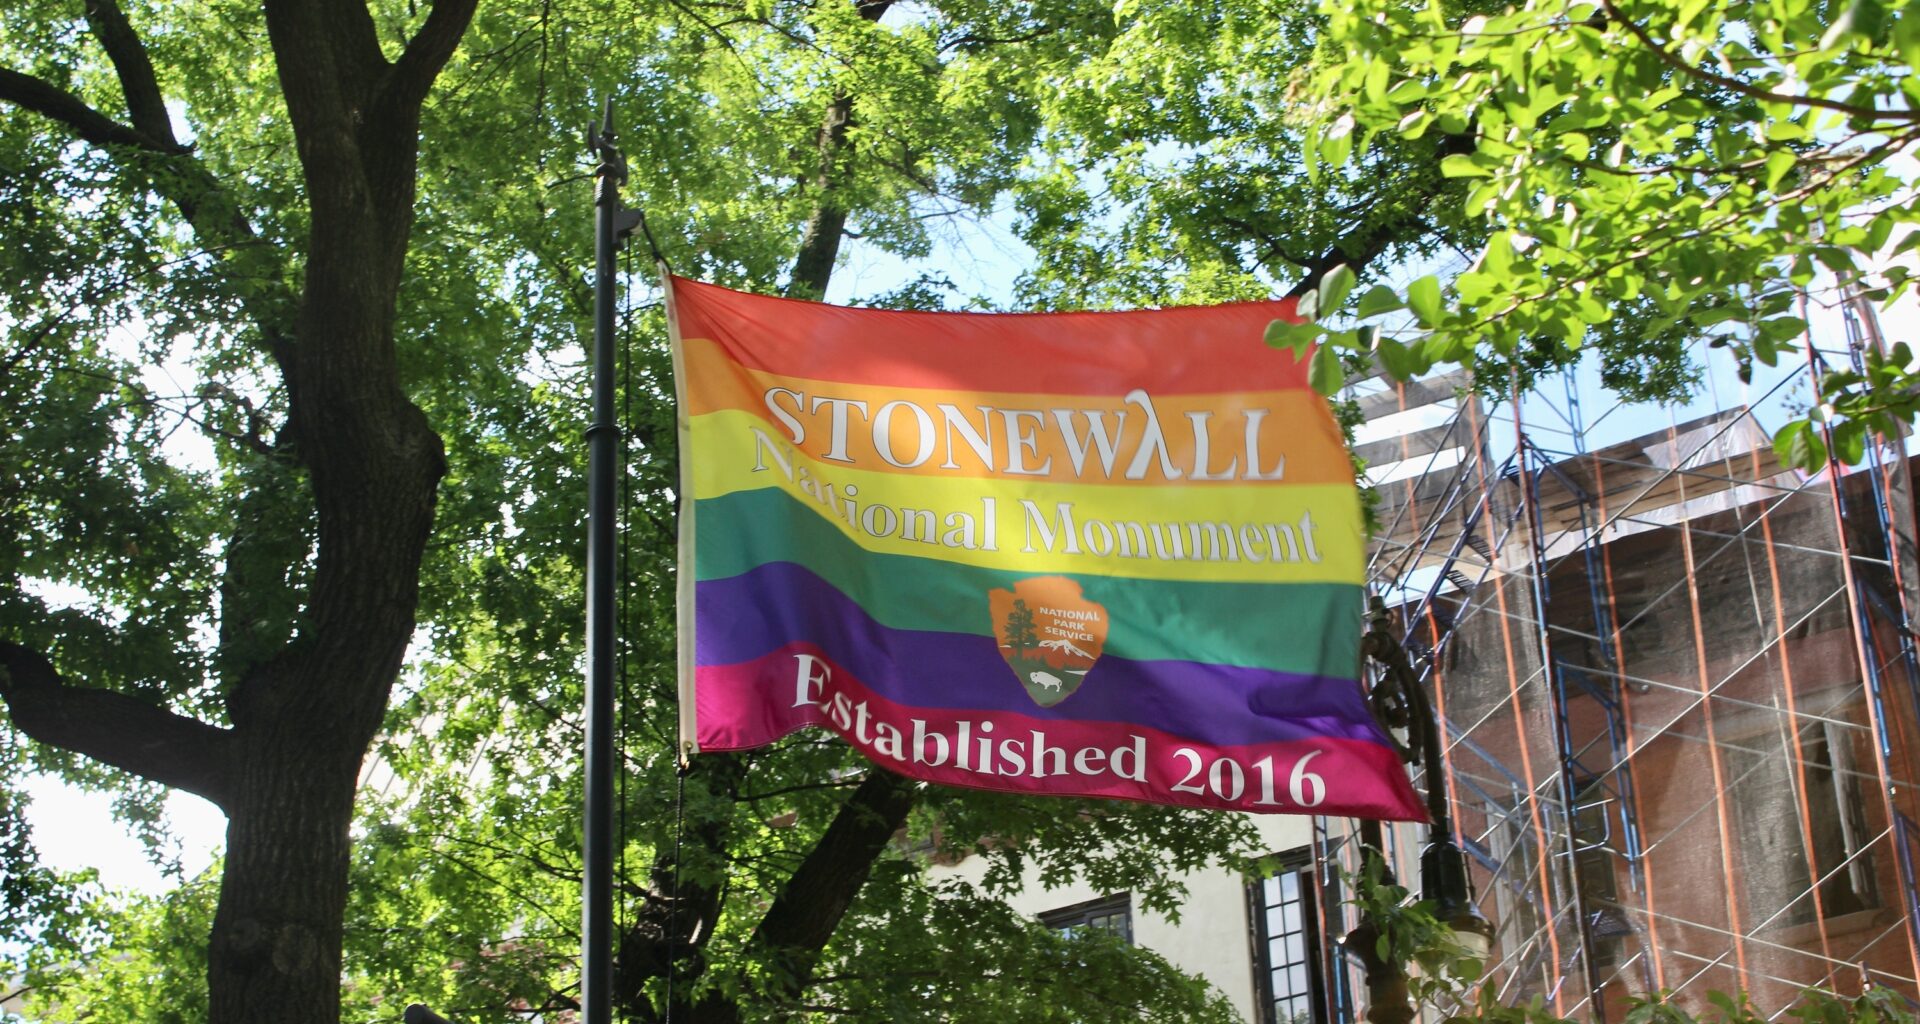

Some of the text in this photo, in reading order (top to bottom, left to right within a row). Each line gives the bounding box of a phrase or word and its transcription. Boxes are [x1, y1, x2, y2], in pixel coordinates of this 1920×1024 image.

[749, 425, 1323, 564] National Monument
[1039, 606, 1100, 621] NATIONAL
[1053, 618, 1086, 631] PARK
[1044, 626, 1094, 642] SERVICE
[792, 654, 1328, 807] Established 2016
